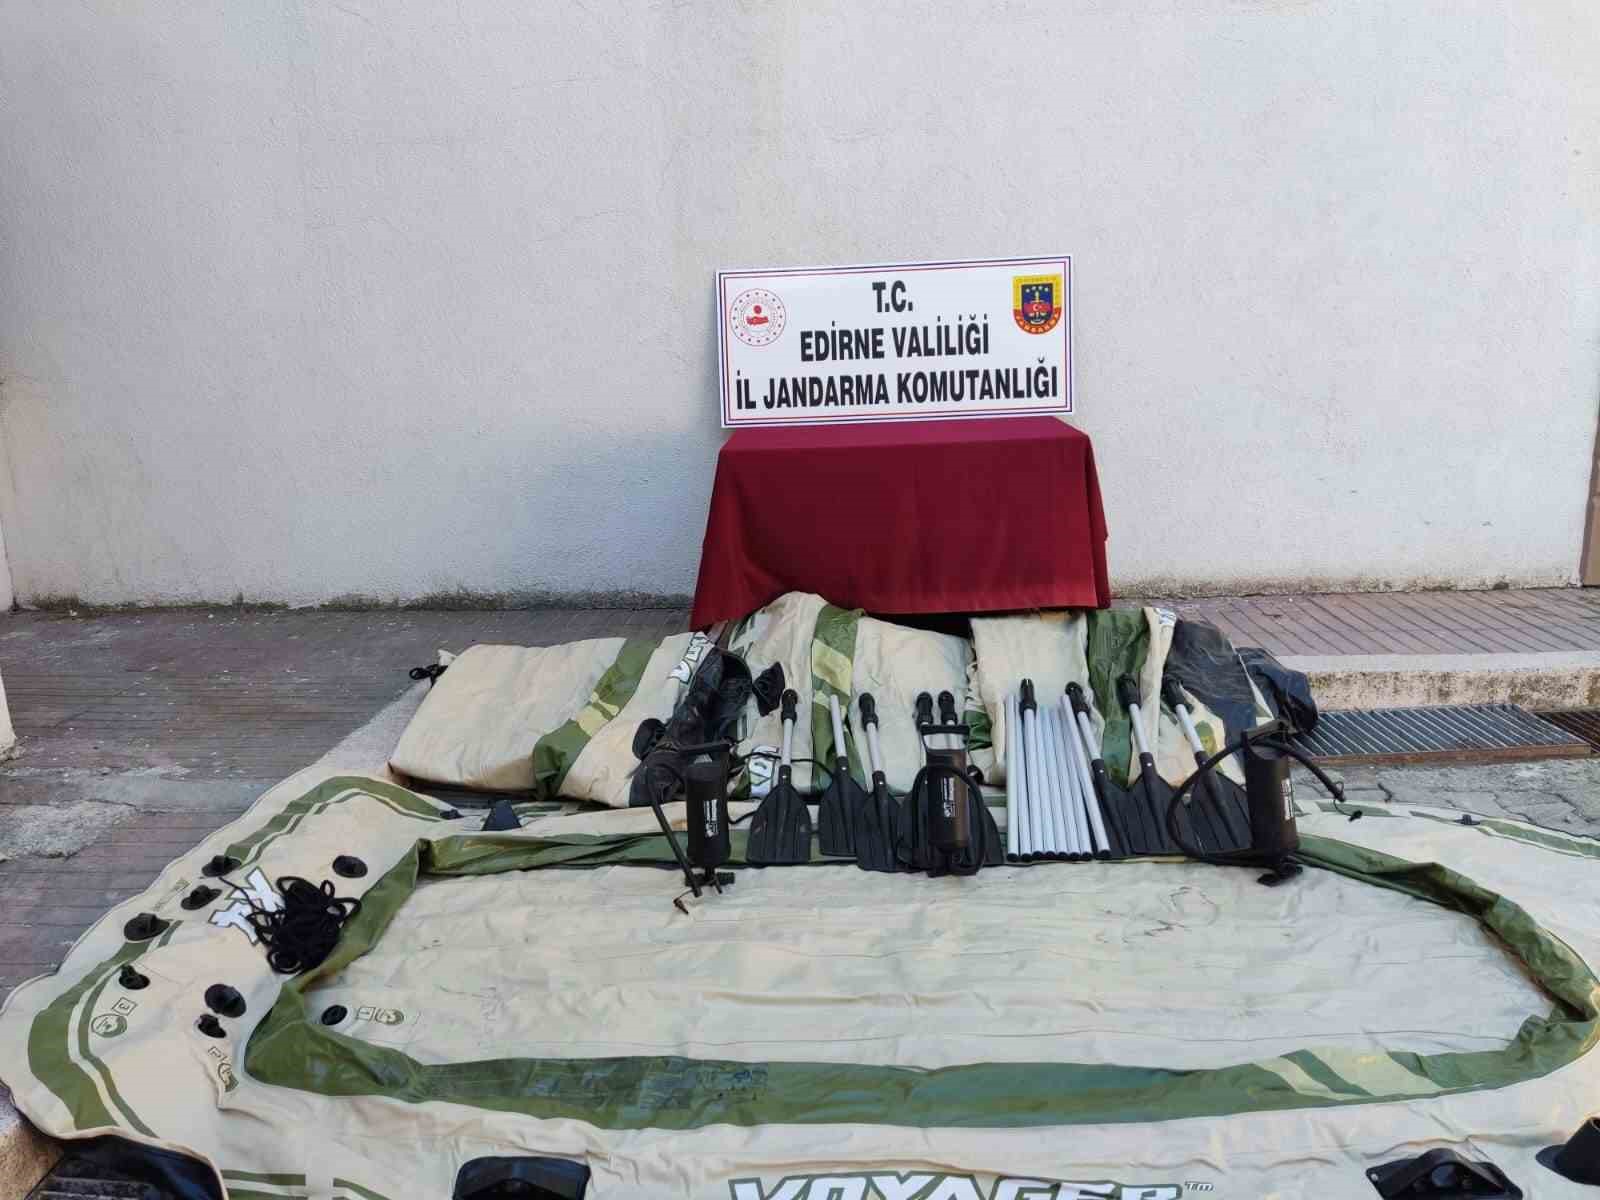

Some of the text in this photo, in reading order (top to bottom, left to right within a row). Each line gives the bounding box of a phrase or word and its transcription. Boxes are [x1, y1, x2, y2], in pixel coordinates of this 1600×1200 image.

[872, 280, 913, 313] T.C.
[800, 313, 989, 362] EDİRNE VALİLİĞİ
[736, 356, 1058, 410] İL JANDARMA KOMUTANLIĞI
